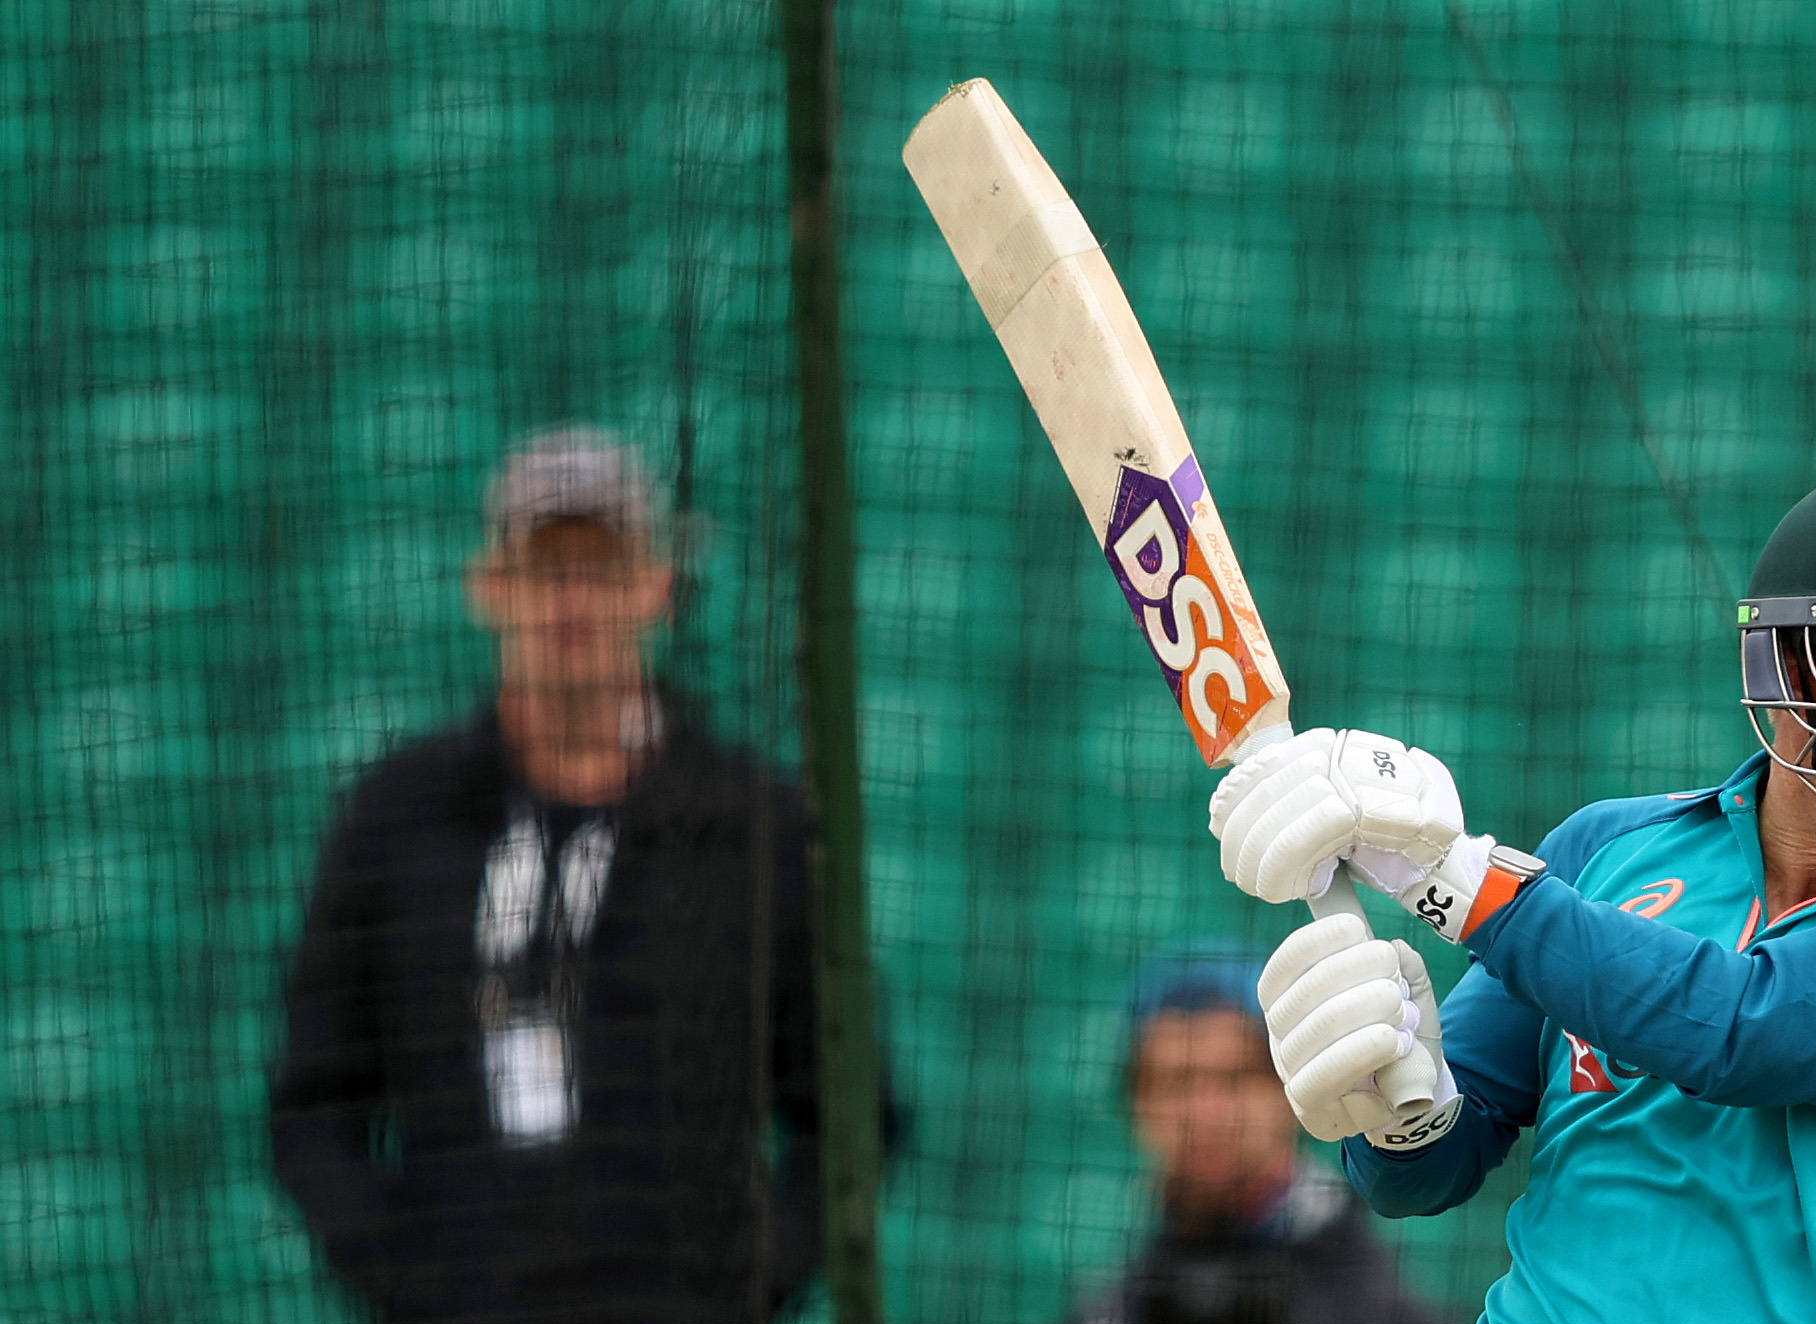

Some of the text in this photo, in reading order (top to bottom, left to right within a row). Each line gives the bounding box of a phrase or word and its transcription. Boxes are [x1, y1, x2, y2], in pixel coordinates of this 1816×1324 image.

[1113, 499, 1248, 738] DSC
[1372, 750, 1396, 779] DSC
[1385, 1111, 1448, 1144] DSC
